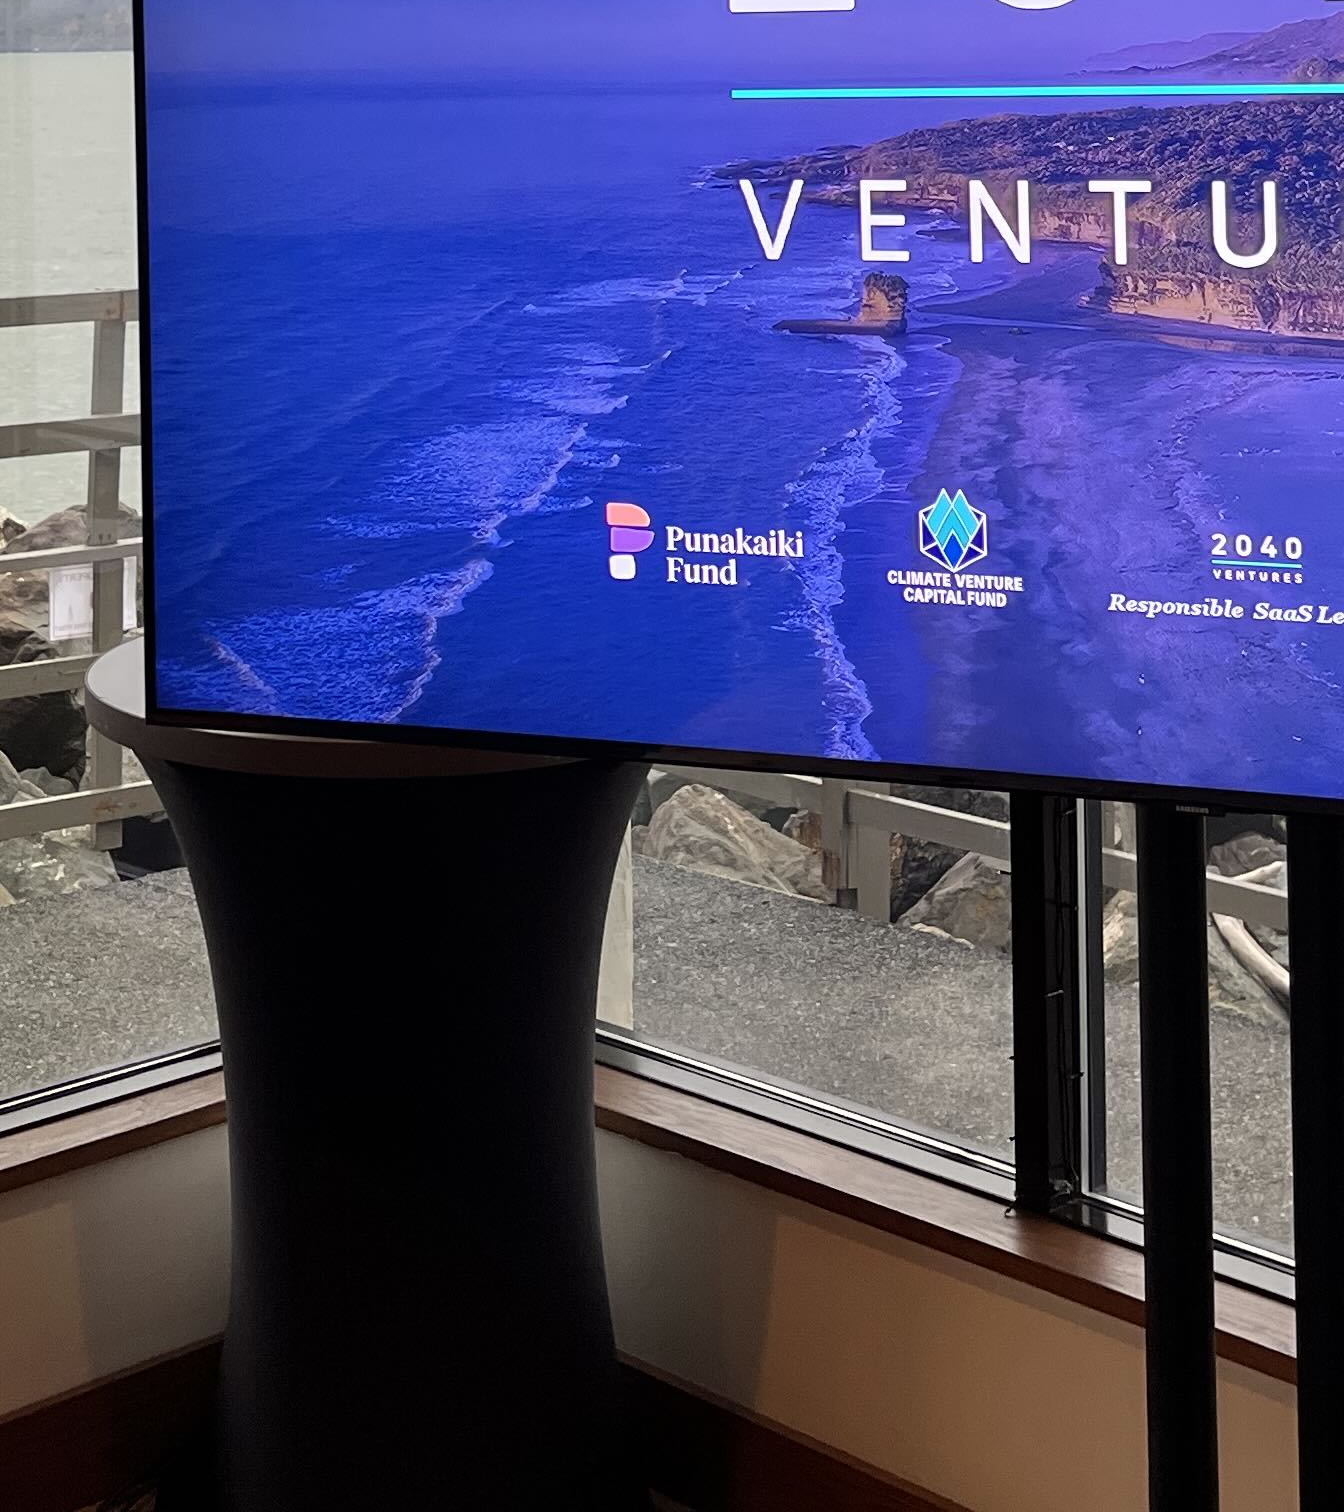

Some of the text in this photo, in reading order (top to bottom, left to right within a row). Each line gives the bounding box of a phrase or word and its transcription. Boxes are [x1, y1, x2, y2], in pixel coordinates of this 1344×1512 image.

[665, 526, 805, 558] Punakaiki
[1211, 533, 1302, 560] 2040
[666, 557, 738, 585] Fund
[887, 569, 1024, 592] CLIMATE VENTURE
[1212, 569, 1303, 584] VENTURES
[903, 587, 1008, 608] CAPITAL FUND
[1107, 593, 1244, 619] Responsible
[1252, 602, 1314, 623] SaaS
